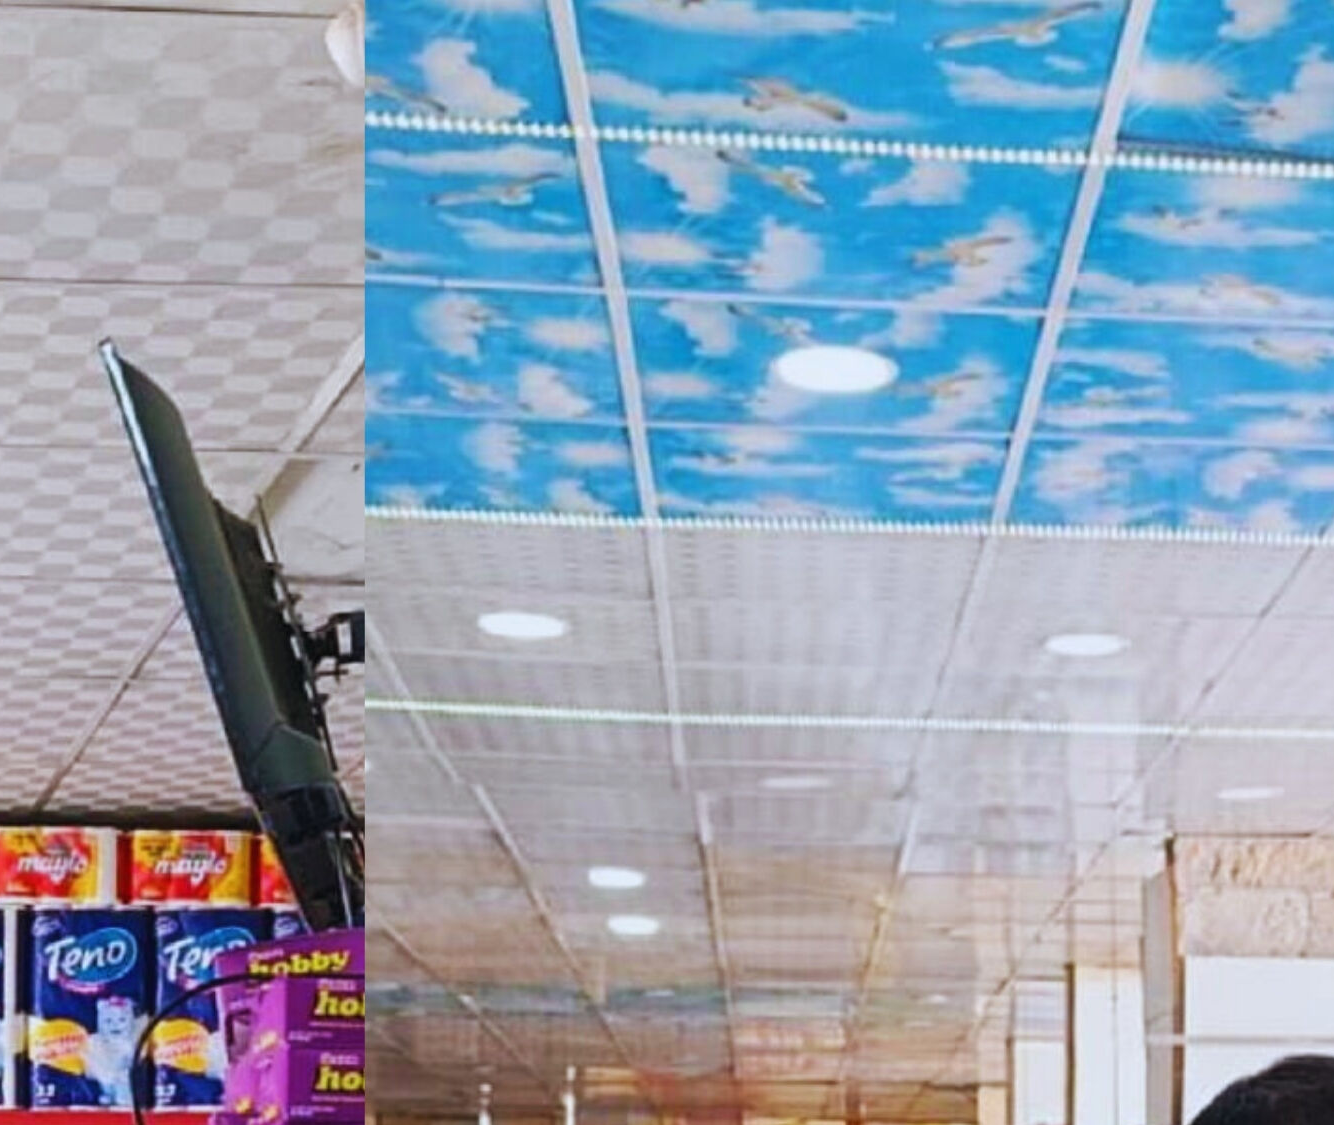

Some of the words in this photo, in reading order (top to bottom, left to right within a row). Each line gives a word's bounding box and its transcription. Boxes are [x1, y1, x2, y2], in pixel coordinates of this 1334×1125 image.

[17, 851, 88, 883] maylo
[154, 853, 227, 884] maylo
[45, 936, 126, 981] Teno
[249, 949, 350, 977] hobby
